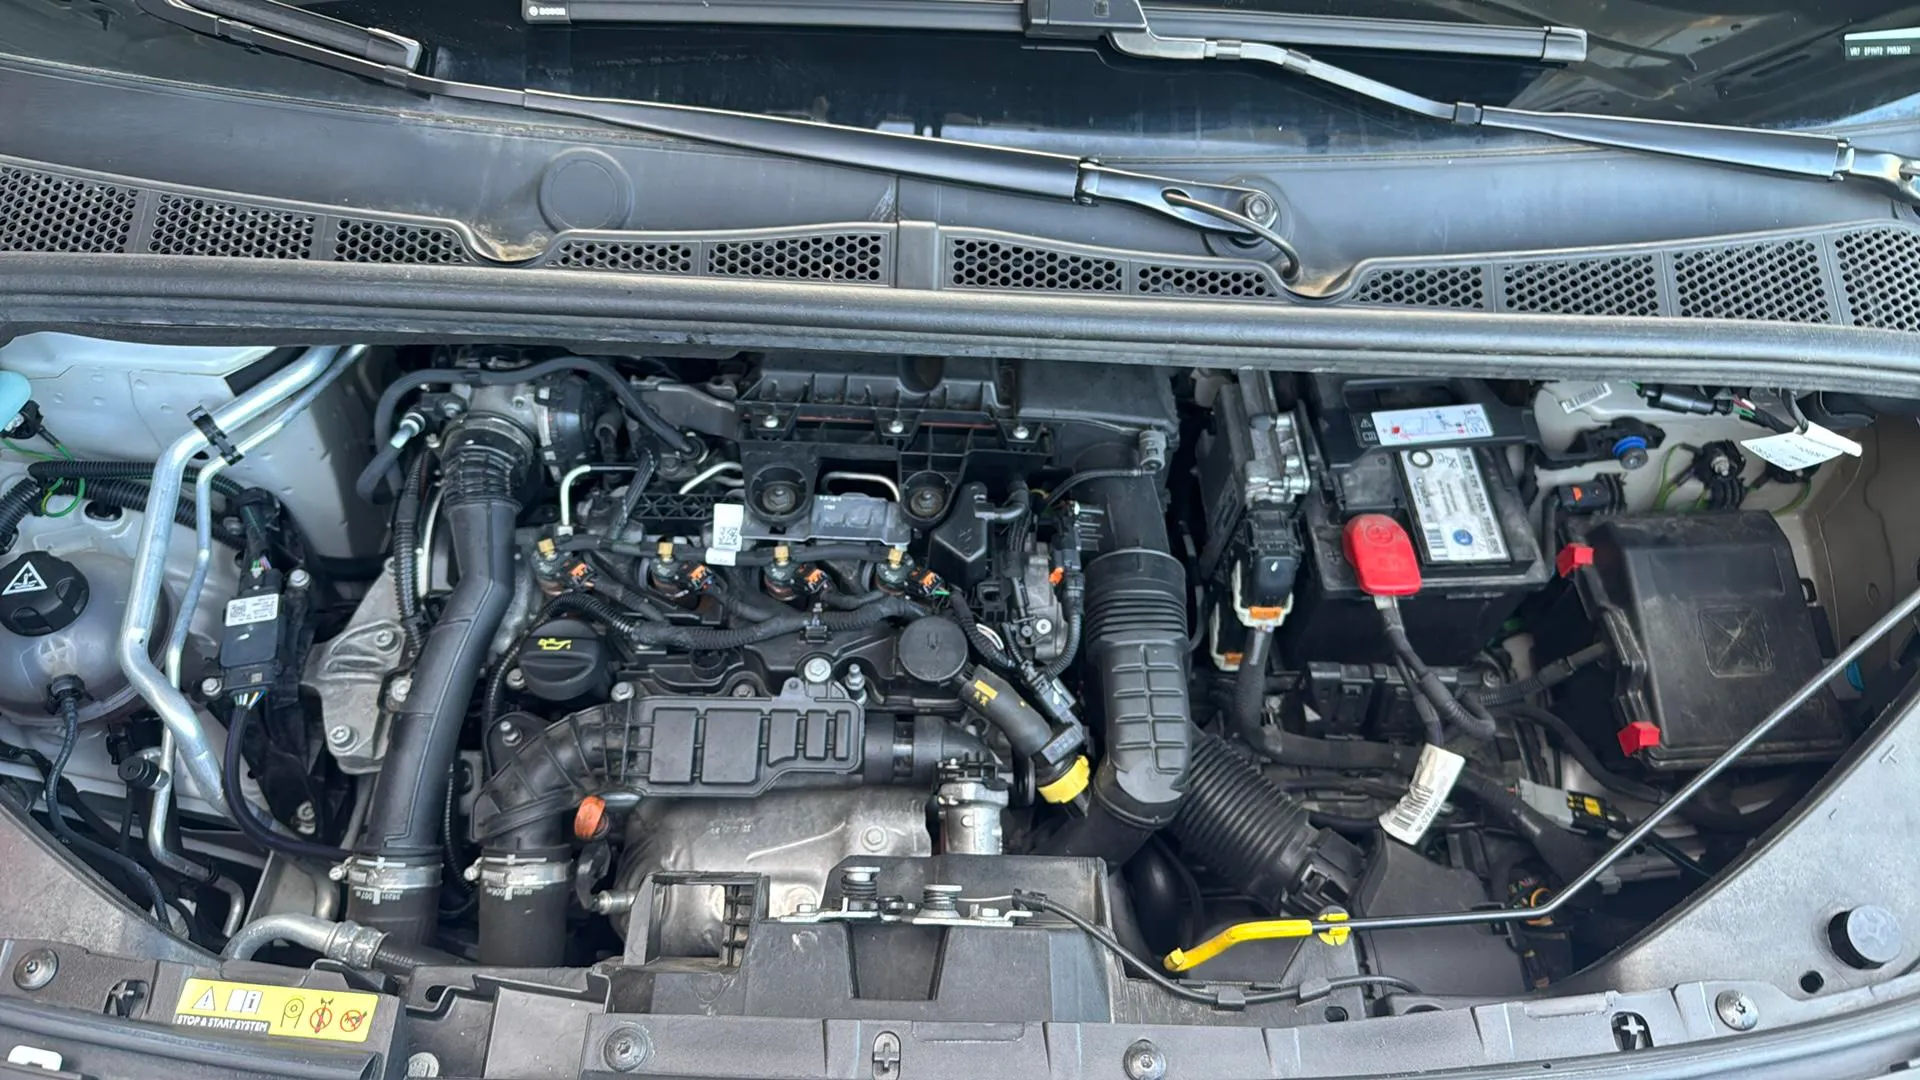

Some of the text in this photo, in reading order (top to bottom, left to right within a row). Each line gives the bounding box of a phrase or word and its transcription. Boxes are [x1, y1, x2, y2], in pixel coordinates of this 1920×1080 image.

[177, 1014, 268, 1032] STOP & START SYSTEM
